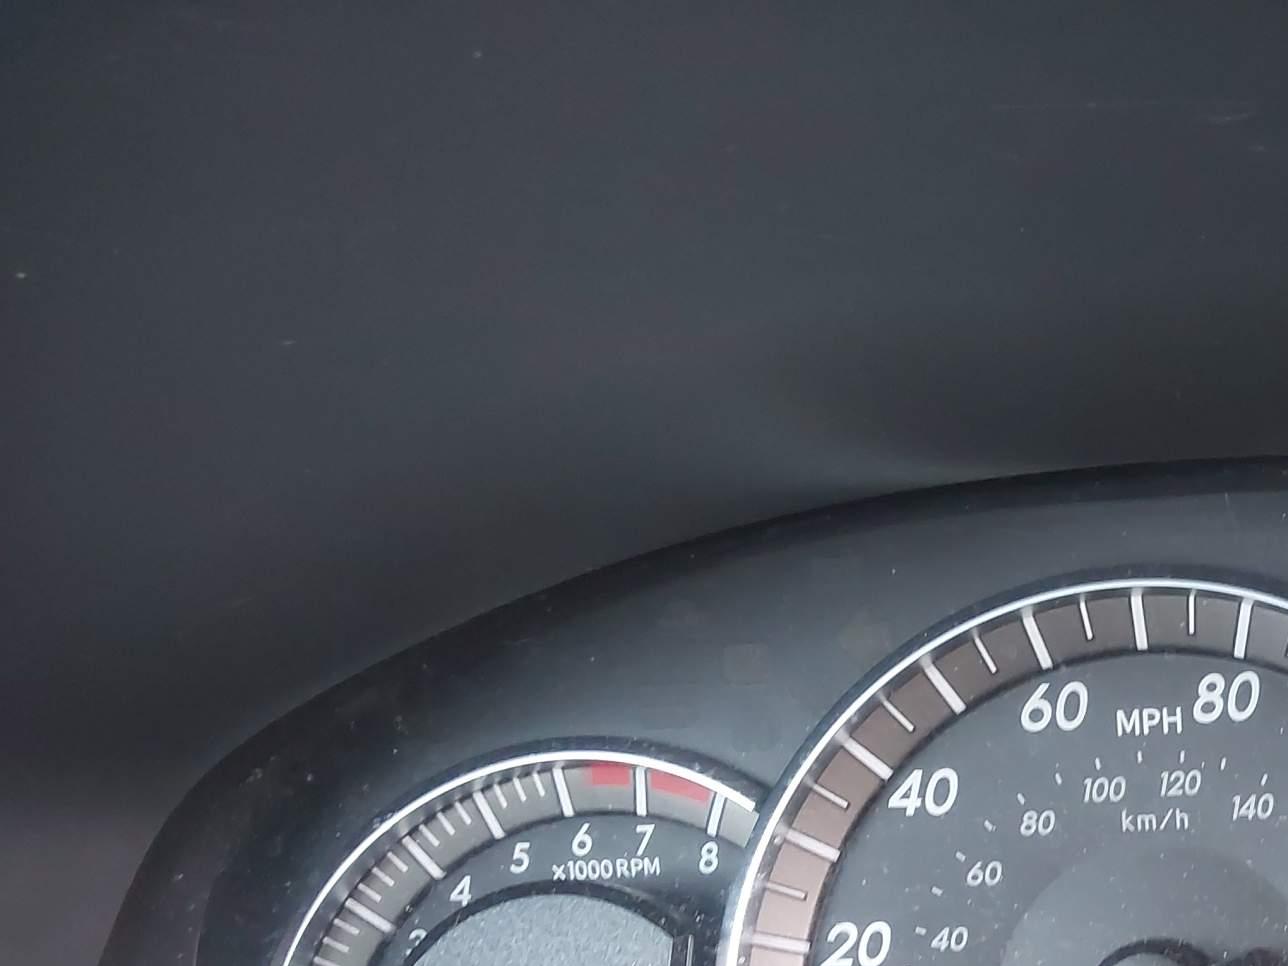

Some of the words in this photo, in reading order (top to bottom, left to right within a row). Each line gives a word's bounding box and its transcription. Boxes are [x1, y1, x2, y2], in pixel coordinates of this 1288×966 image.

[1020, 681, 1089, 732] 60
[1193, 671, 1260, 724] 80
[1116, 706, 1183, 737] MPH
[888, 768, 959, 817] 40
[1083, 776, 1126, 803] 100
[1160, 769, 1201, 797] 120
[1121, 808, 1189, 832] km/h
[1232, 793, 1275, 821] 140
[1020, 810, 1056, 836] 80
[571, 823, 593, 856] 6
[635, 823, 655, 856] 7
[510, 842, 530, 873] 5
[699, 841, 719, 874] 8
[966, 861, 1002, 887] 60
[449, 875, 472, 906] 4
[931, 926, 969, 952] 40
